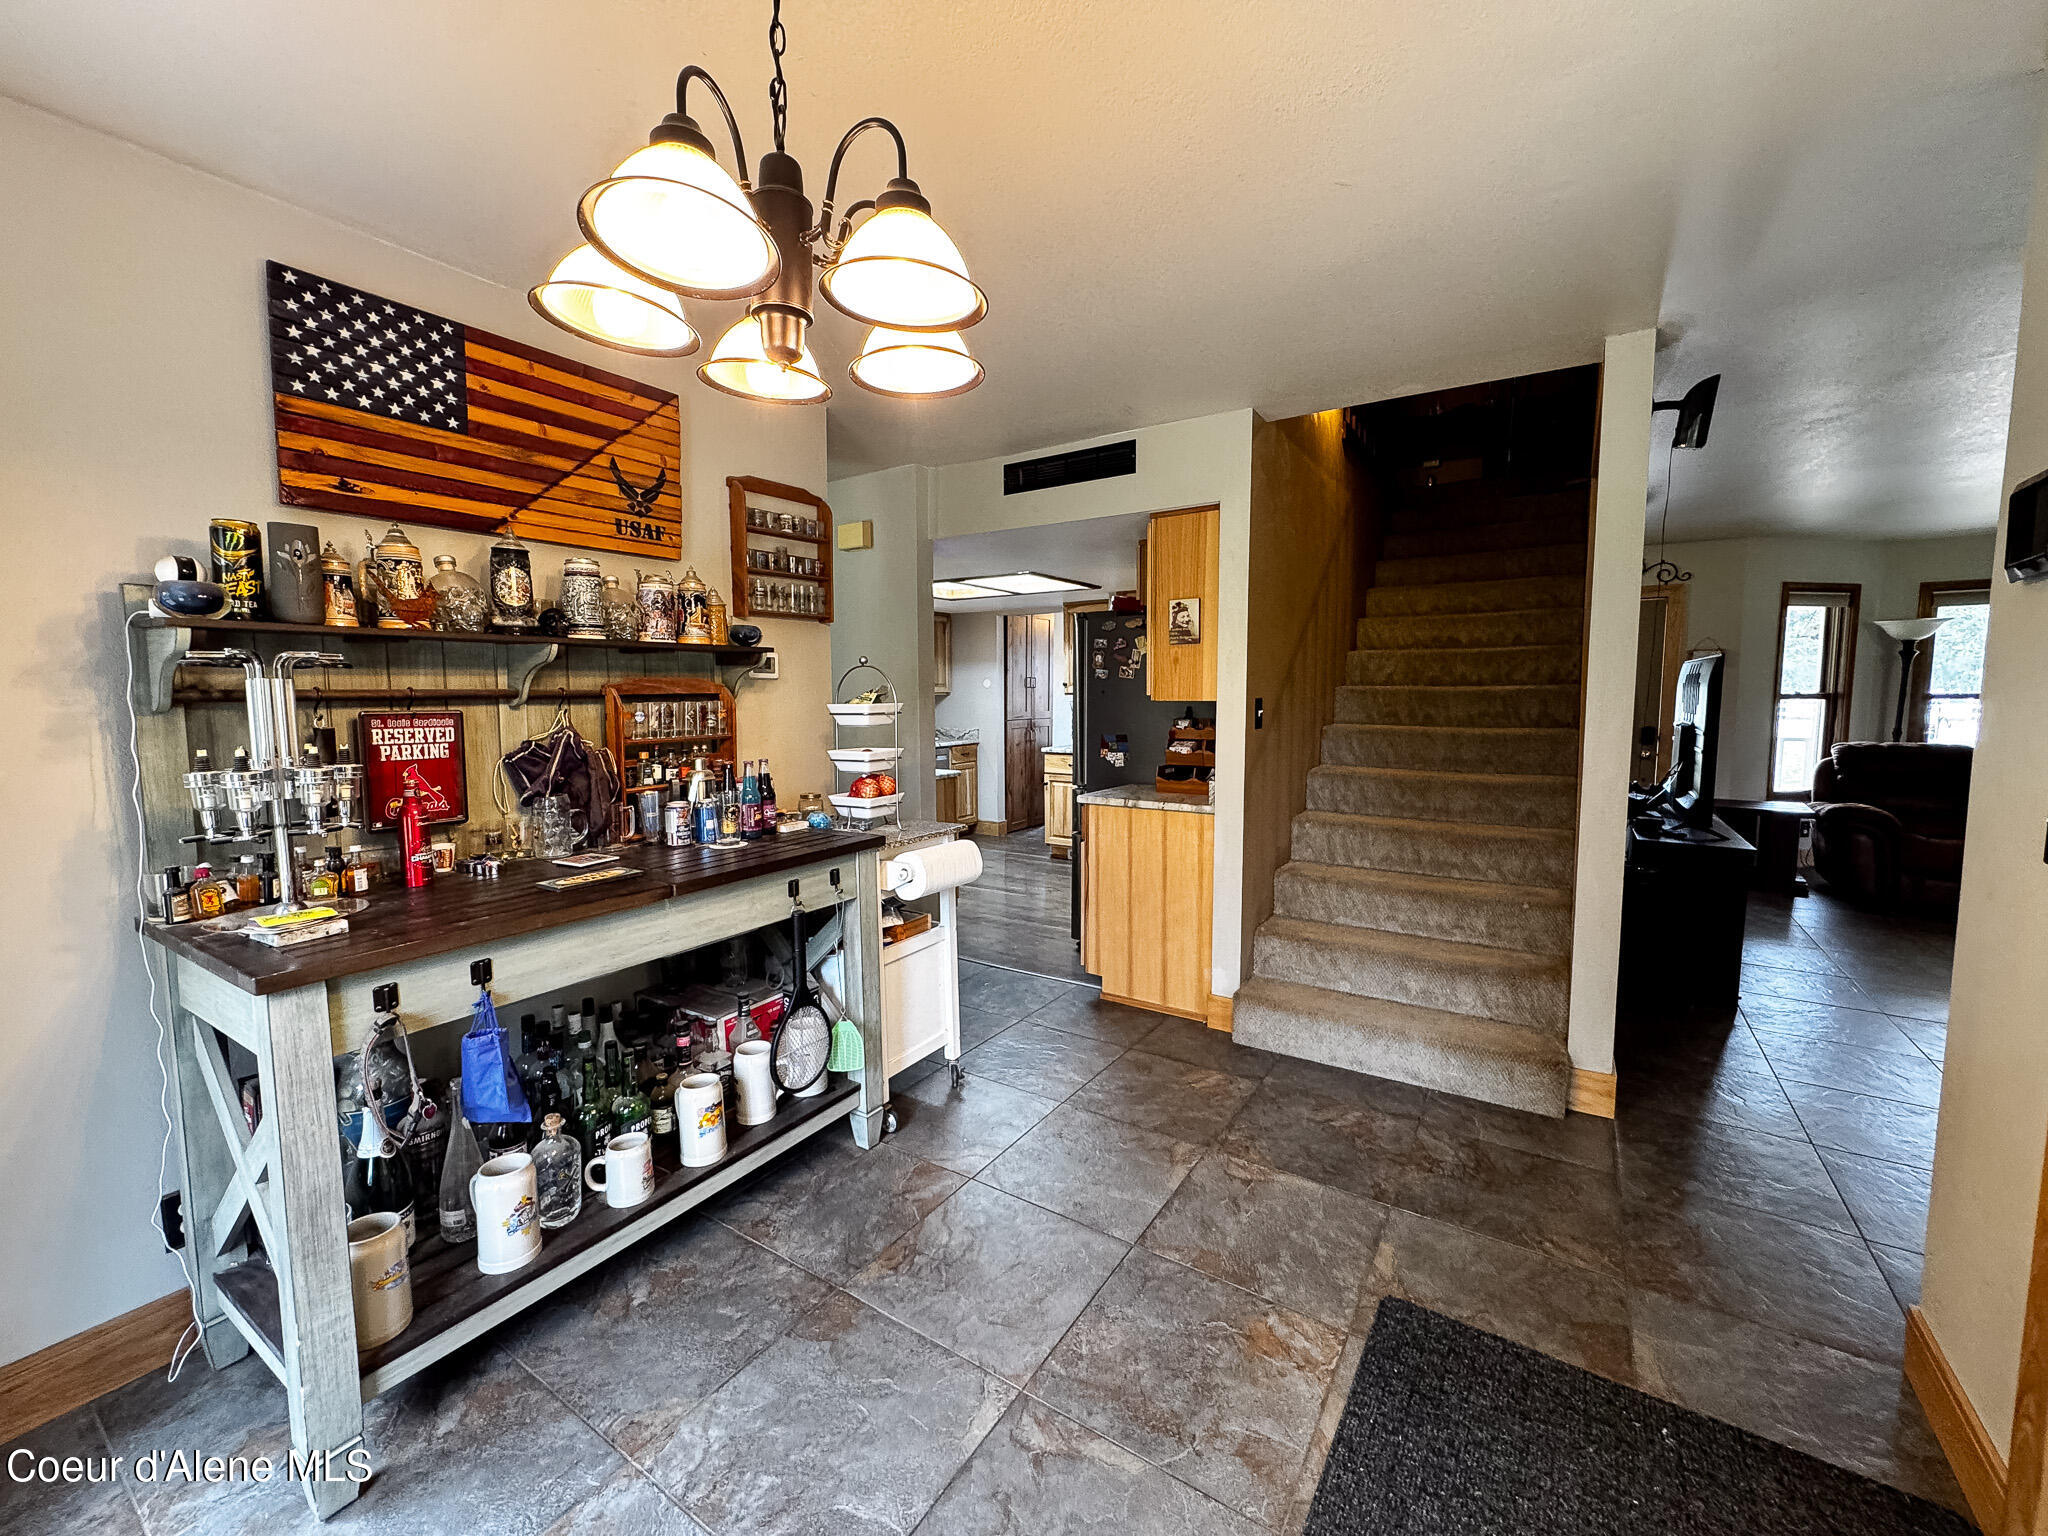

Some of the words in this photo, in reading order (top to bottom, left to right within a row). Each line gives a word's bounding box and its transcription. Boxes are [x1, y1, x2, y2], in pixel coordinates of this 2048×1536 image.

[614, 518, 666, 541] USAF
[222, 569, 254, 583] NASTY
[225, 580, 262, 597] EAST
[371, 727, 455, 745] RESERVED
[380, 743, 450, 761] PARKING
